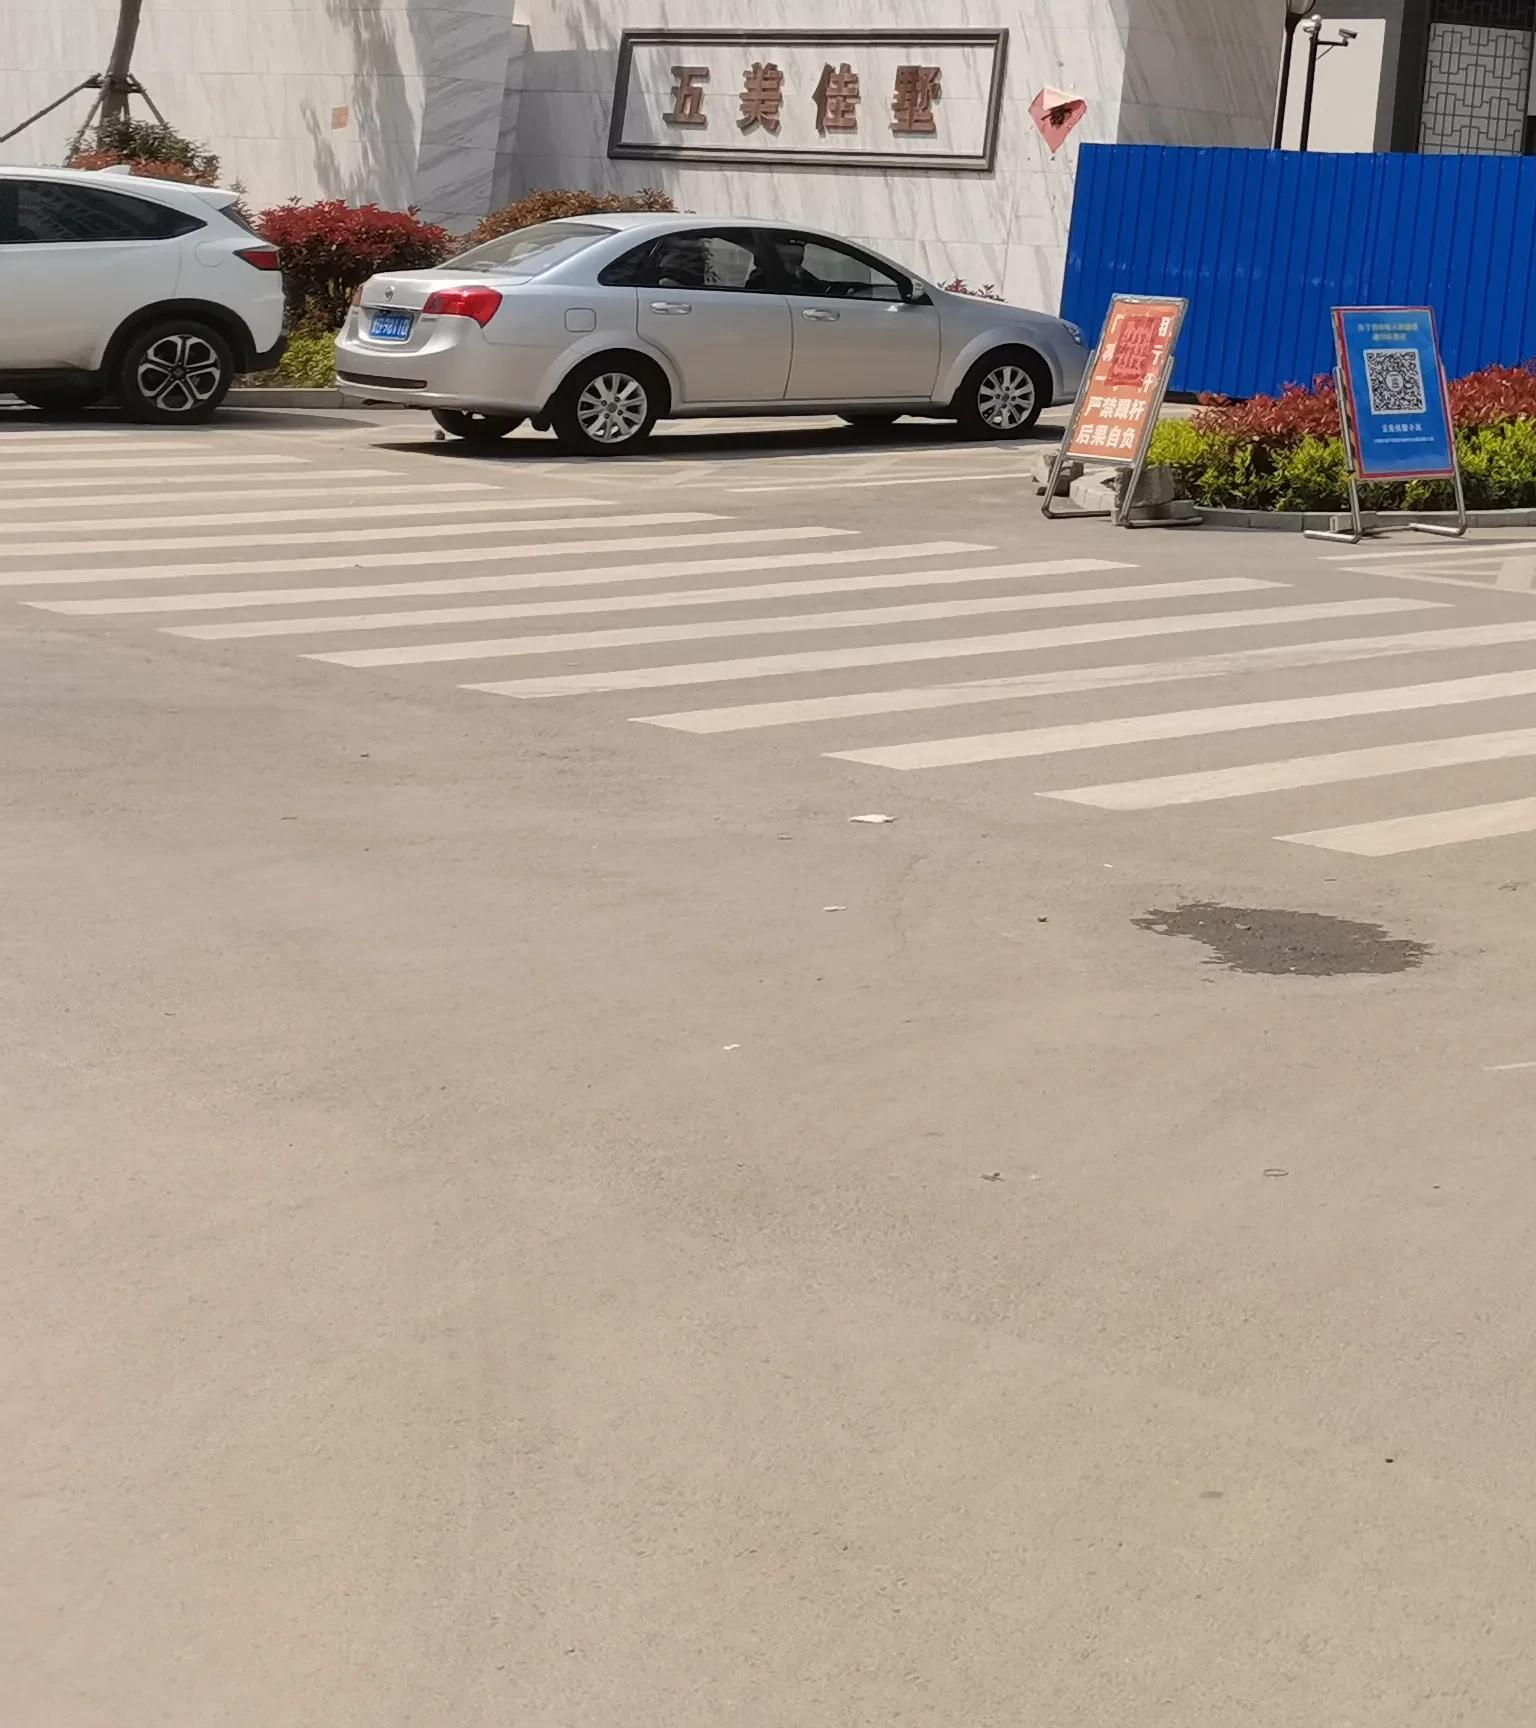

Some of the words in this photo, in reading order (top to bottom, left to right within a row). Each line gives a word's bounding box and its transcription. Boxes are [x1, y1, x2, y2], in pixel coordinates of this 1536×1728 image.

[663, 62, 942, 136] 五美佳墅
[1076, 424, 1137, 449] 后果自负
